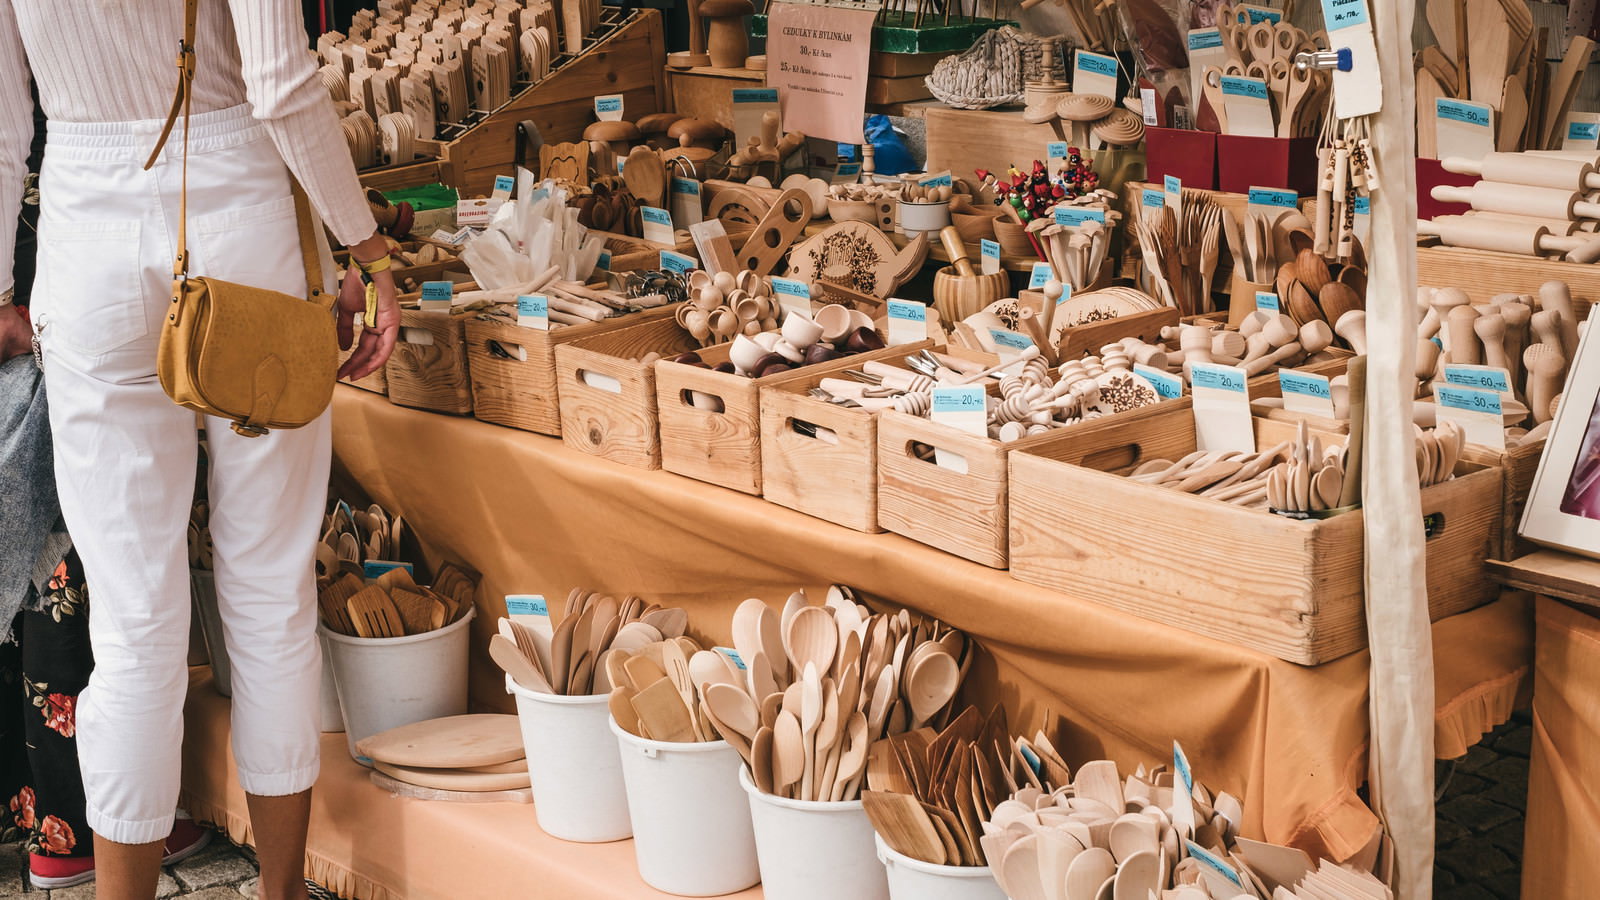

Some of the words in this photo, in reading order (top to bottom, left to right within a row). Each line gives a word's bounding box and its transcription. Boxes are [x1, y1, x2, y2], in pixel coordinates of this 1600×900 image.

[782, 26, 812, 38] CEDULKY
[812, 29, 817, 38] K
[818, 30, 852, 42] BYLINKÁM
[800, 45, 811, 56] 30,-
[780, 61, 792, 72] 25,-
[1270, 194, 1297, 206] 40,-Kč
[1220, 376, 1244, 390] 20,-Kč
[1480, 376, 1508, 390] 60,-Kč
[961, 394, 985, 406] 20,-Kč
[1473, 396, 1501, 411] 30,-Kč
